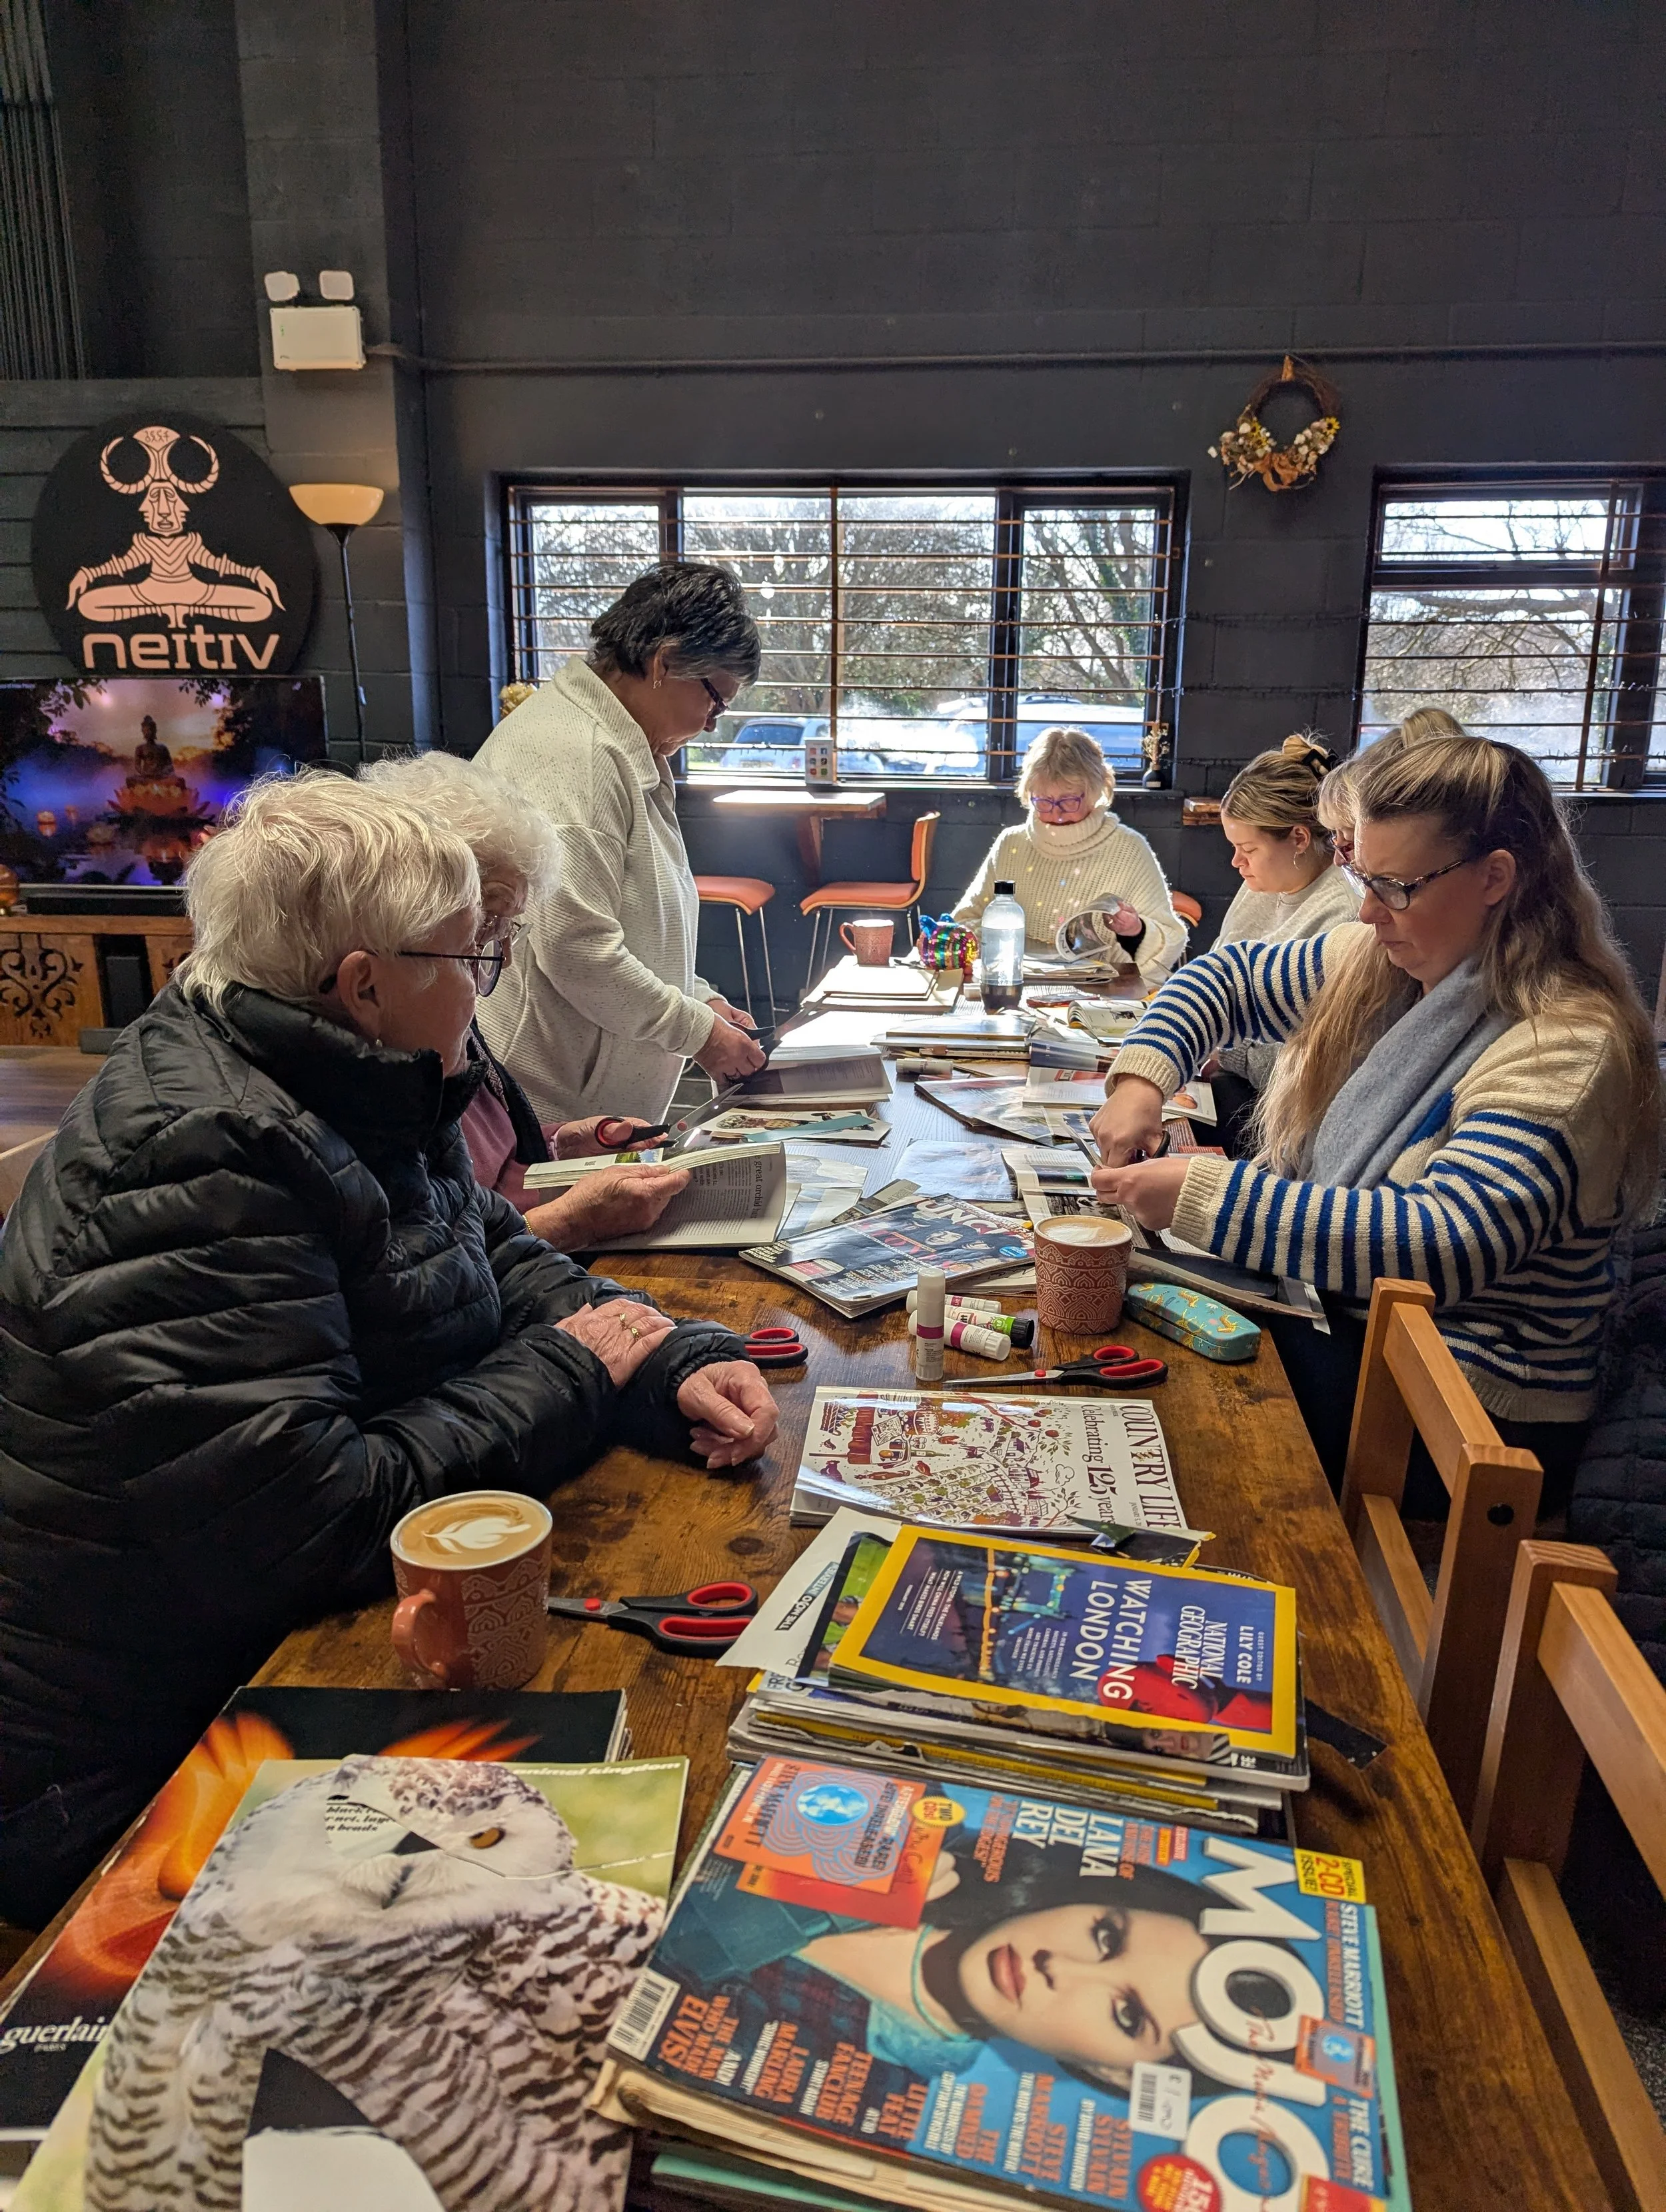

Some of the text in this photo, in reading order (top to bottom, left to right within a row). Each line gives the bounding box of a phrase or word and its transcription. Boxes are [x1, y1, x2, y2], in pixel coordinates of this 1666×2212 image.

[754, 1161, 764, 1182] great
[754, 1185, 764, 1207] orchid
[1081, 1404, 1108, 1463] Celebrating
[1119, 1405, 1171, 1490] COUNTRY
[1086, 1465, 1118, 1496] 125
[779, 1614, 794, 1631] THE
[793, 1594, 814, 1616] MOJO
[1069, 1580, 1118, 1681] LONDON
[1102, 1580, 1152, 1700] WATCHING
[1170, 1605, 1206, 1690] GEOGRAPHIC
[1199, 1620, 1228, 1680] NATIONAL
[1236, 1625, 1254, 1684] LILY COLE
[938, 1802, 954, 1822] TWO
[1011, 1800, 1054, 1850] REY
[1047, 1807, 1089, 1848] DEL
[1079, 1813, 1124, 1878] LANA
[1343, 1860, 1357, 1898] SPECIAL
[1340, 1903, 1365, 2030] STEVE MARRIOTT
[657, 1994, 708, 2073] ELVIS!
[681, 1995, 731, 2075] WHO MADE
[699, 2017, 740, 2081] THE MAN
[1170, 1836, 1331, 2212] MOJO
[752, 2021, 798, 2100] MARLING
[772, 2045, 810, 2105] LAURA
[798, 2059, 830, 2117] START AGAIN
[813, 2041, 856, 2121] FANCLUB
[834, 2051, 873, 2127] TEENAGE
[936, 2071, 957, 2108] CAPTAIN
[897, 2083, 928, 2141] LITTLE
[942, 2099, 965, 2143] MADNESS
[954, 2083, 989, 2160] DAMNED
[1020, 2073, 1055, 2178] MARRIOTT
[1075, 2114, 1094, 2142] DAVID
[1079, 2098, 1096, 2113] BY
[973, 2129, 1000, 2165] THE
[1041, 2124, 1068, 2183] STEVE
[1086, 2115, 1114, 2195] SYLVAIN
[1108, 2119, 1132, 2199] SYLVAIN
[1349, 2099, 1374, 2192] THE CURE
